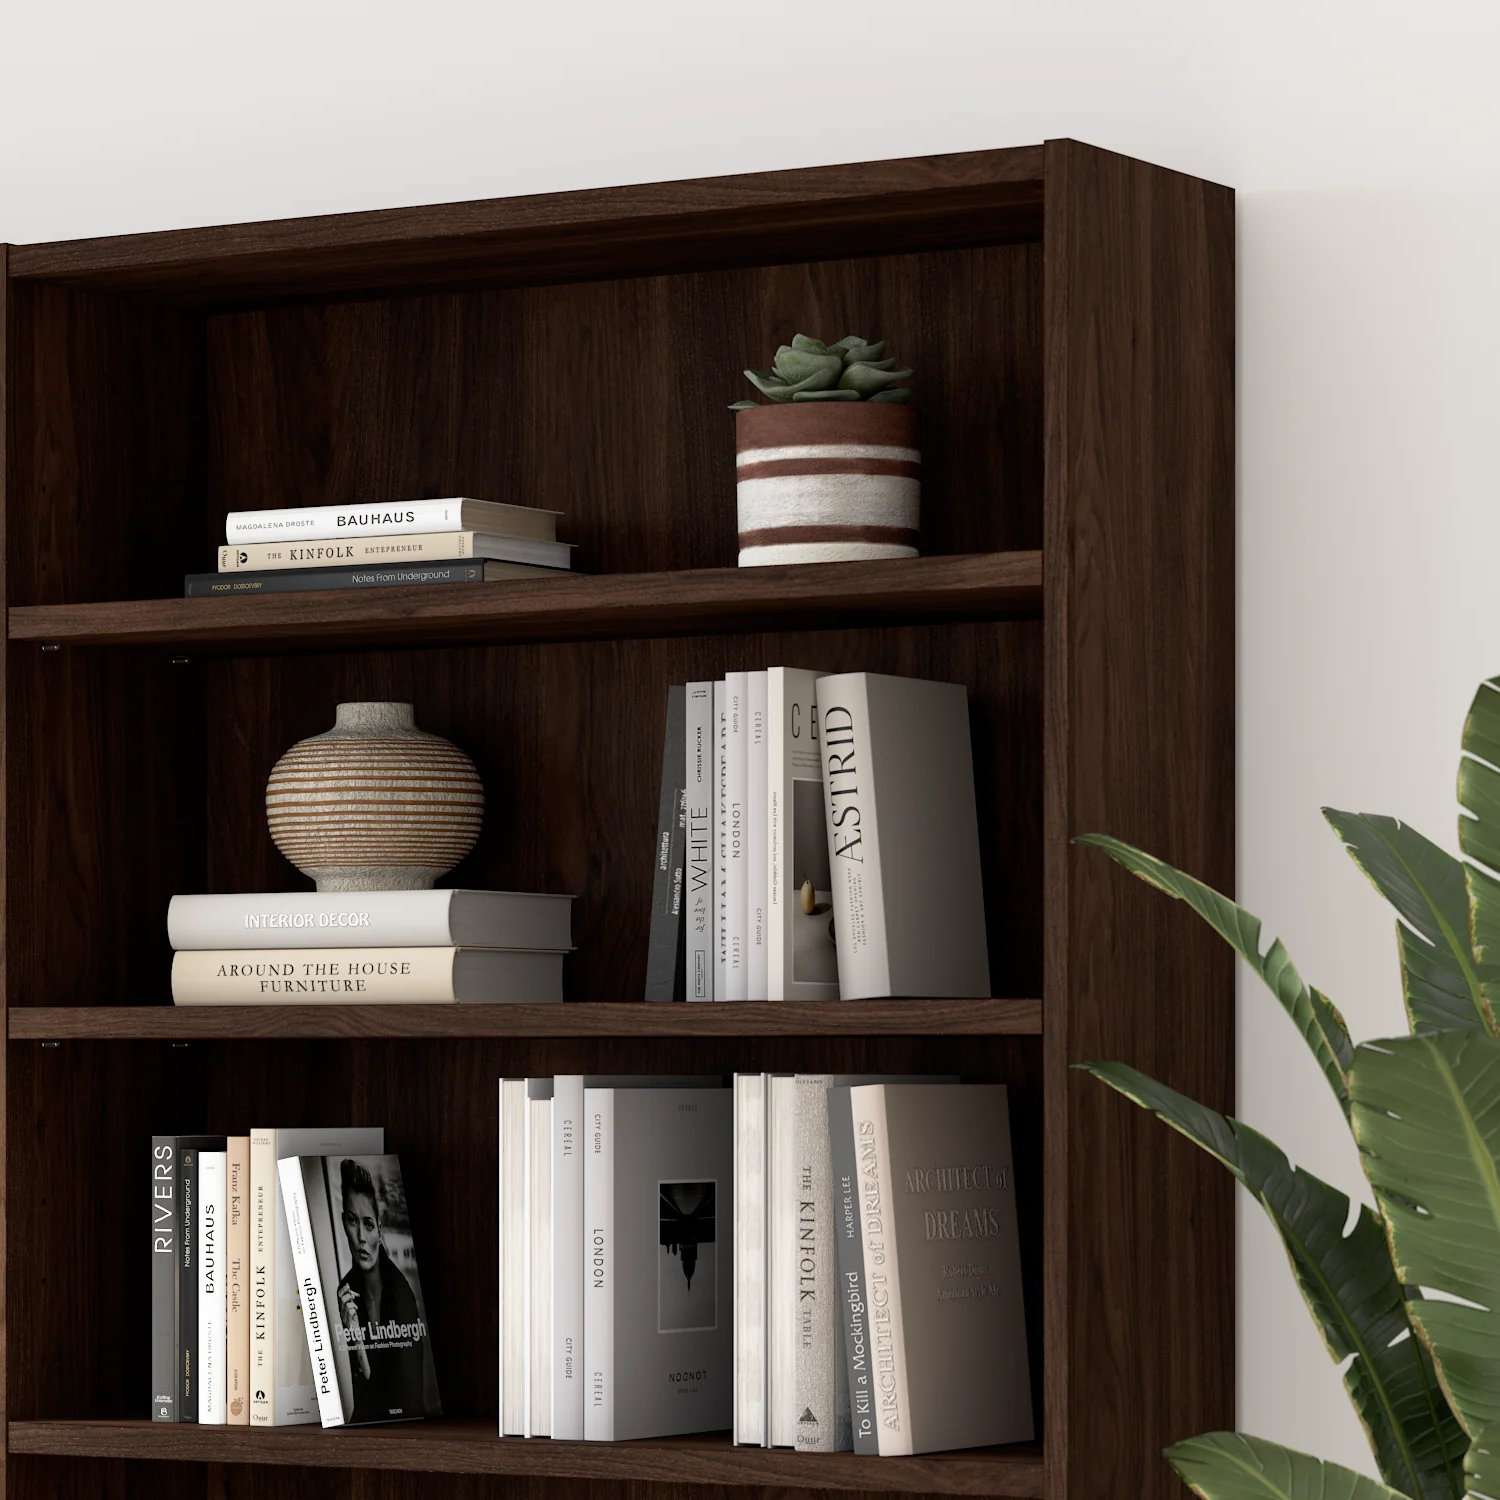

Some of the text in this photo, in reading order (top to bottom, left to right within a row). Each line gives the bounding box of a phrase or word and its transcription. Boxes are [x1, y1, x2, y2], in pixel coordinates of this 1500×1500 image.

[336, 511, 415, 527] BAUHAUS
[267, 544, 424, 560] THE KINFOLK ENTEPRENEUR
[352, 570, 450, 584] Notes From Underground
[754, 712, 762, 744] CEREAL
[824, 706, 864, 864] ÆSTRID
[659, 832, 670, 870] architettura
[690, 807, 708, 892] WHITE
[732, 802, 740, 858] LONDON
[244, 912, 370, 928] INTERIOR DECOR
[216, 962, 411, 976] AROUND THE HOUSE
[732, 936, 740, 970] CEREAL
[260, 980, 366, 992] FURNITURE
[563, 1120, 572, 1158] CEREAL
[154, 1146, 172, 1253] RIVERS
[184, 1179, 192, 1227] Underground
[231, 1162, 240, 1226] Franz Kafka
[924, 1208, 1000, 1240] DREAMS
[205, 1204, 214, 1294] BAUHAUS
[593, 1228, 604, 1288] LONDON
[800, 1166, 816, 1350] THE KINFOLK TABLE
[857, 1120, 901, 1432] ARCHITECT of DREAMS
[256, 1265, 266, 1340] KINFOLK
[302, 1277, 330, 1394] Peter Lindbergh
[334, 1318, 427, 1342] Peter Lindbergh
